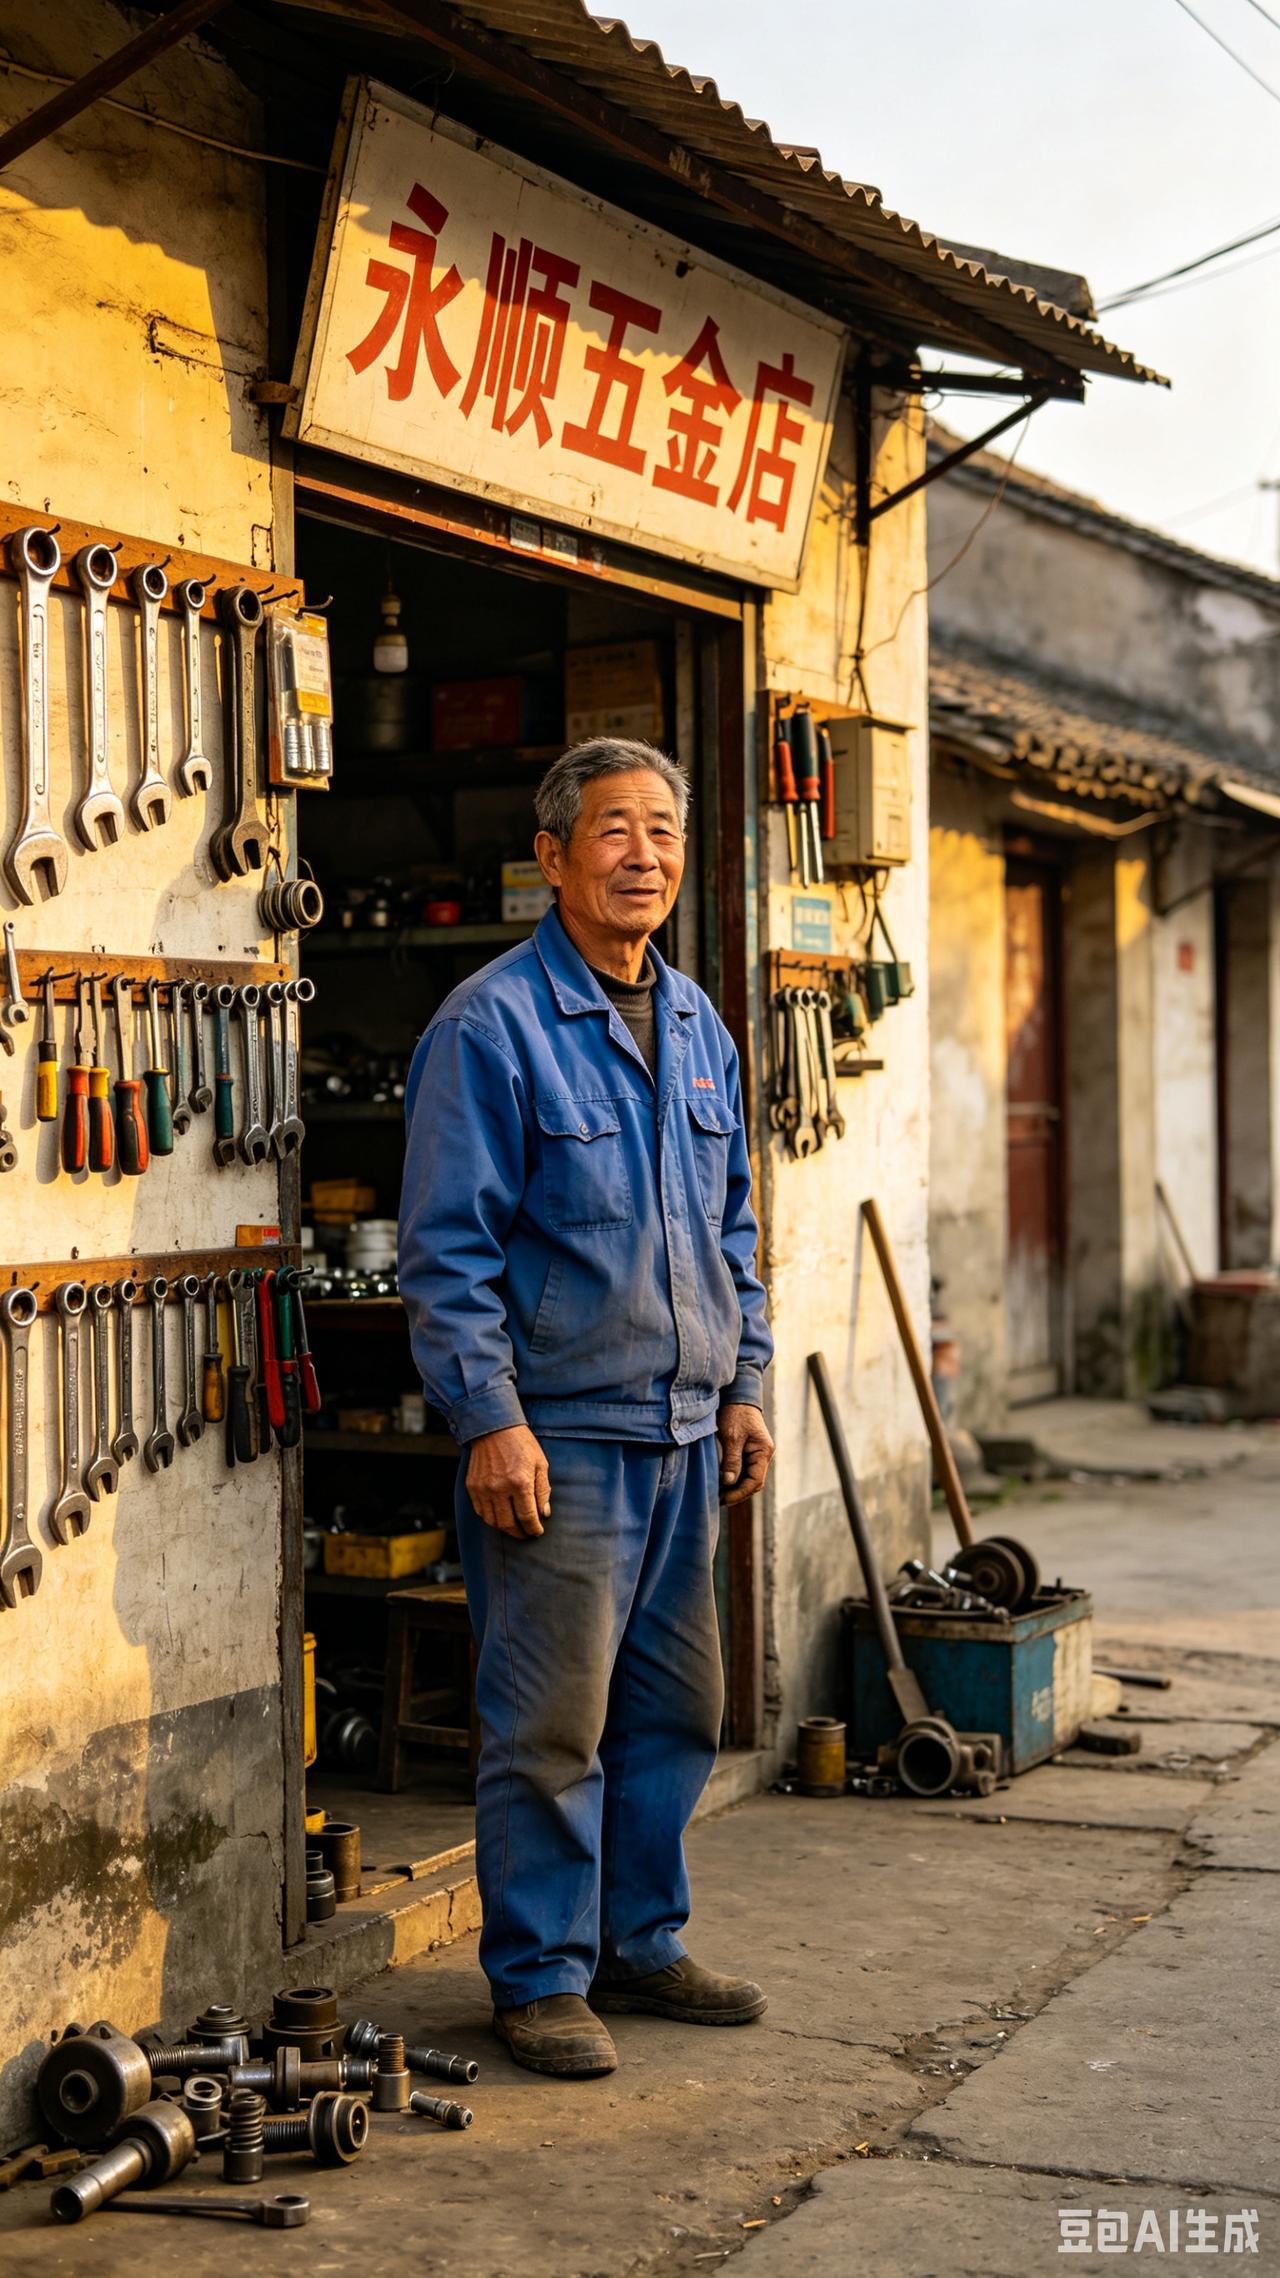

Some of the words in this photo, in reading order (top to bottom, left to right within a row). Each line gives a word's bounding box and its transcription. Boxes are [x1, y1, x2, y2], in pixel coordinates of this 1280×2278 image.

[346, 182, 814, 533] 永顺五金店
